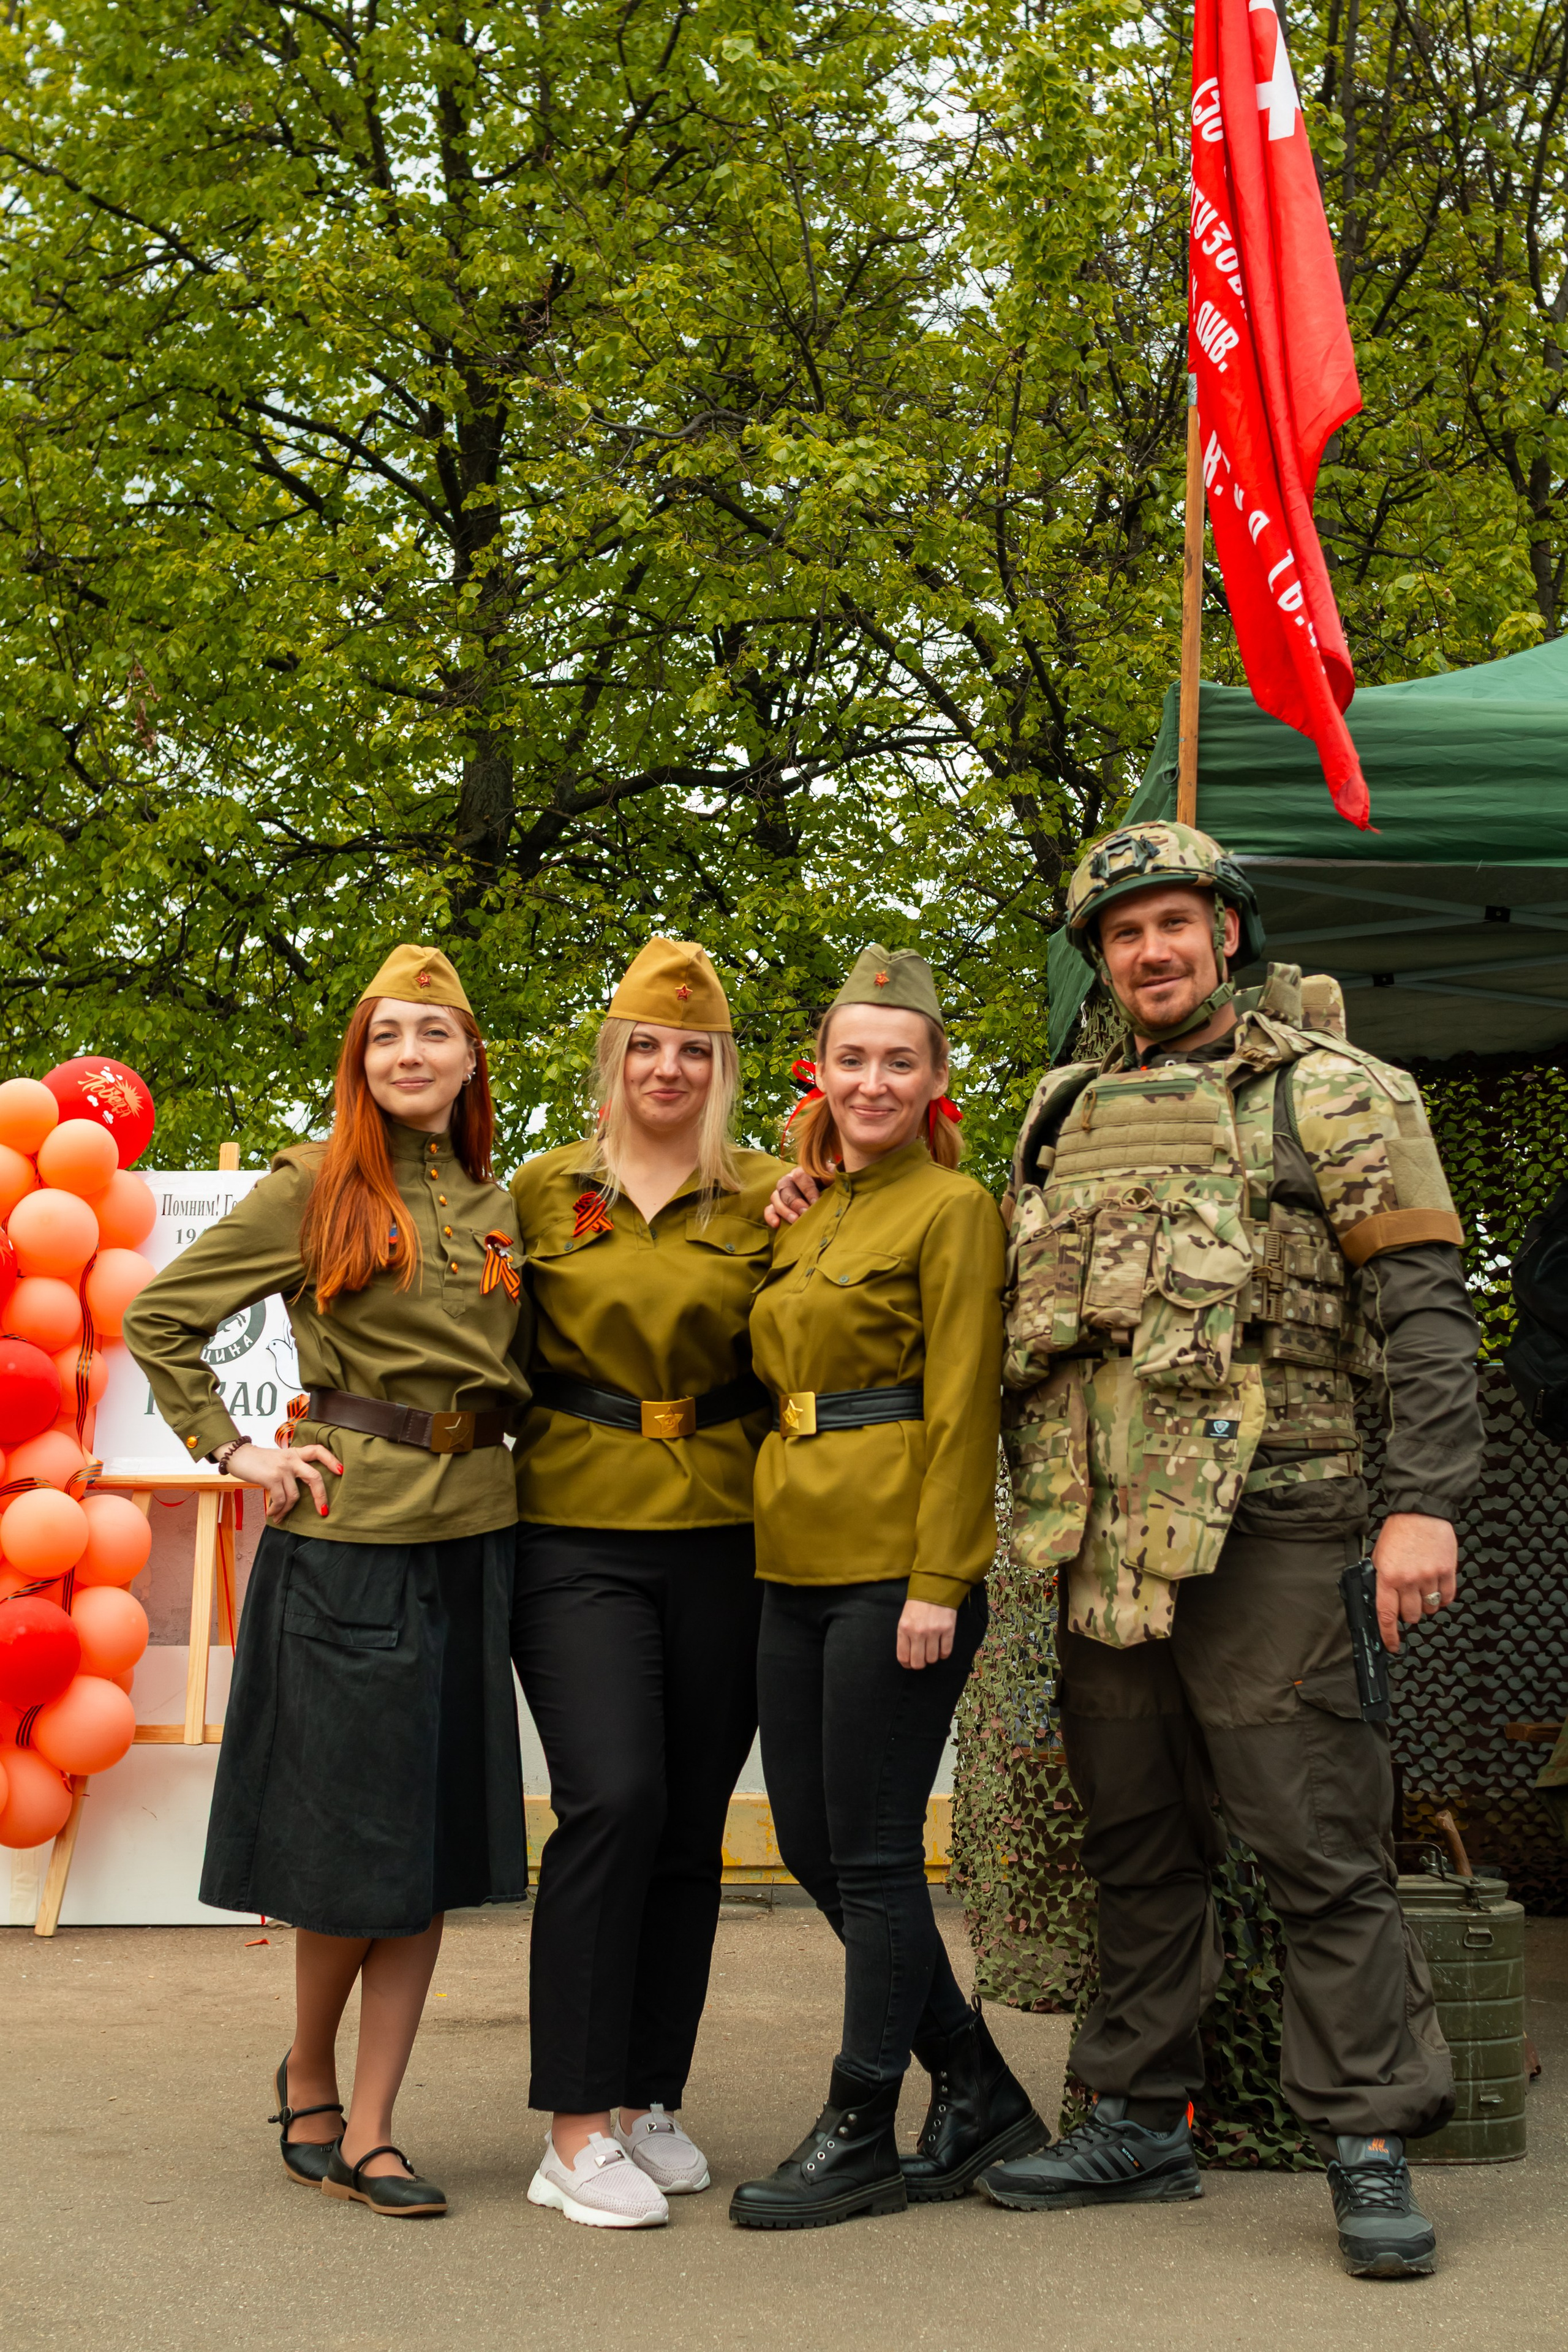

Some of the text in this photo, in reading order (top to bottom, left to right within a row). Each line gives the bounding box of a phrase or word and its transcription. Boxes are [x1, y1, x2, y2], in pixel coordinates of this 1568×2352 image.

[161, 1194, 220, 1216] Помним!
[175, 1228, 207, 1245] 19
[200, 1334, 254, 1363] ЦИНА
